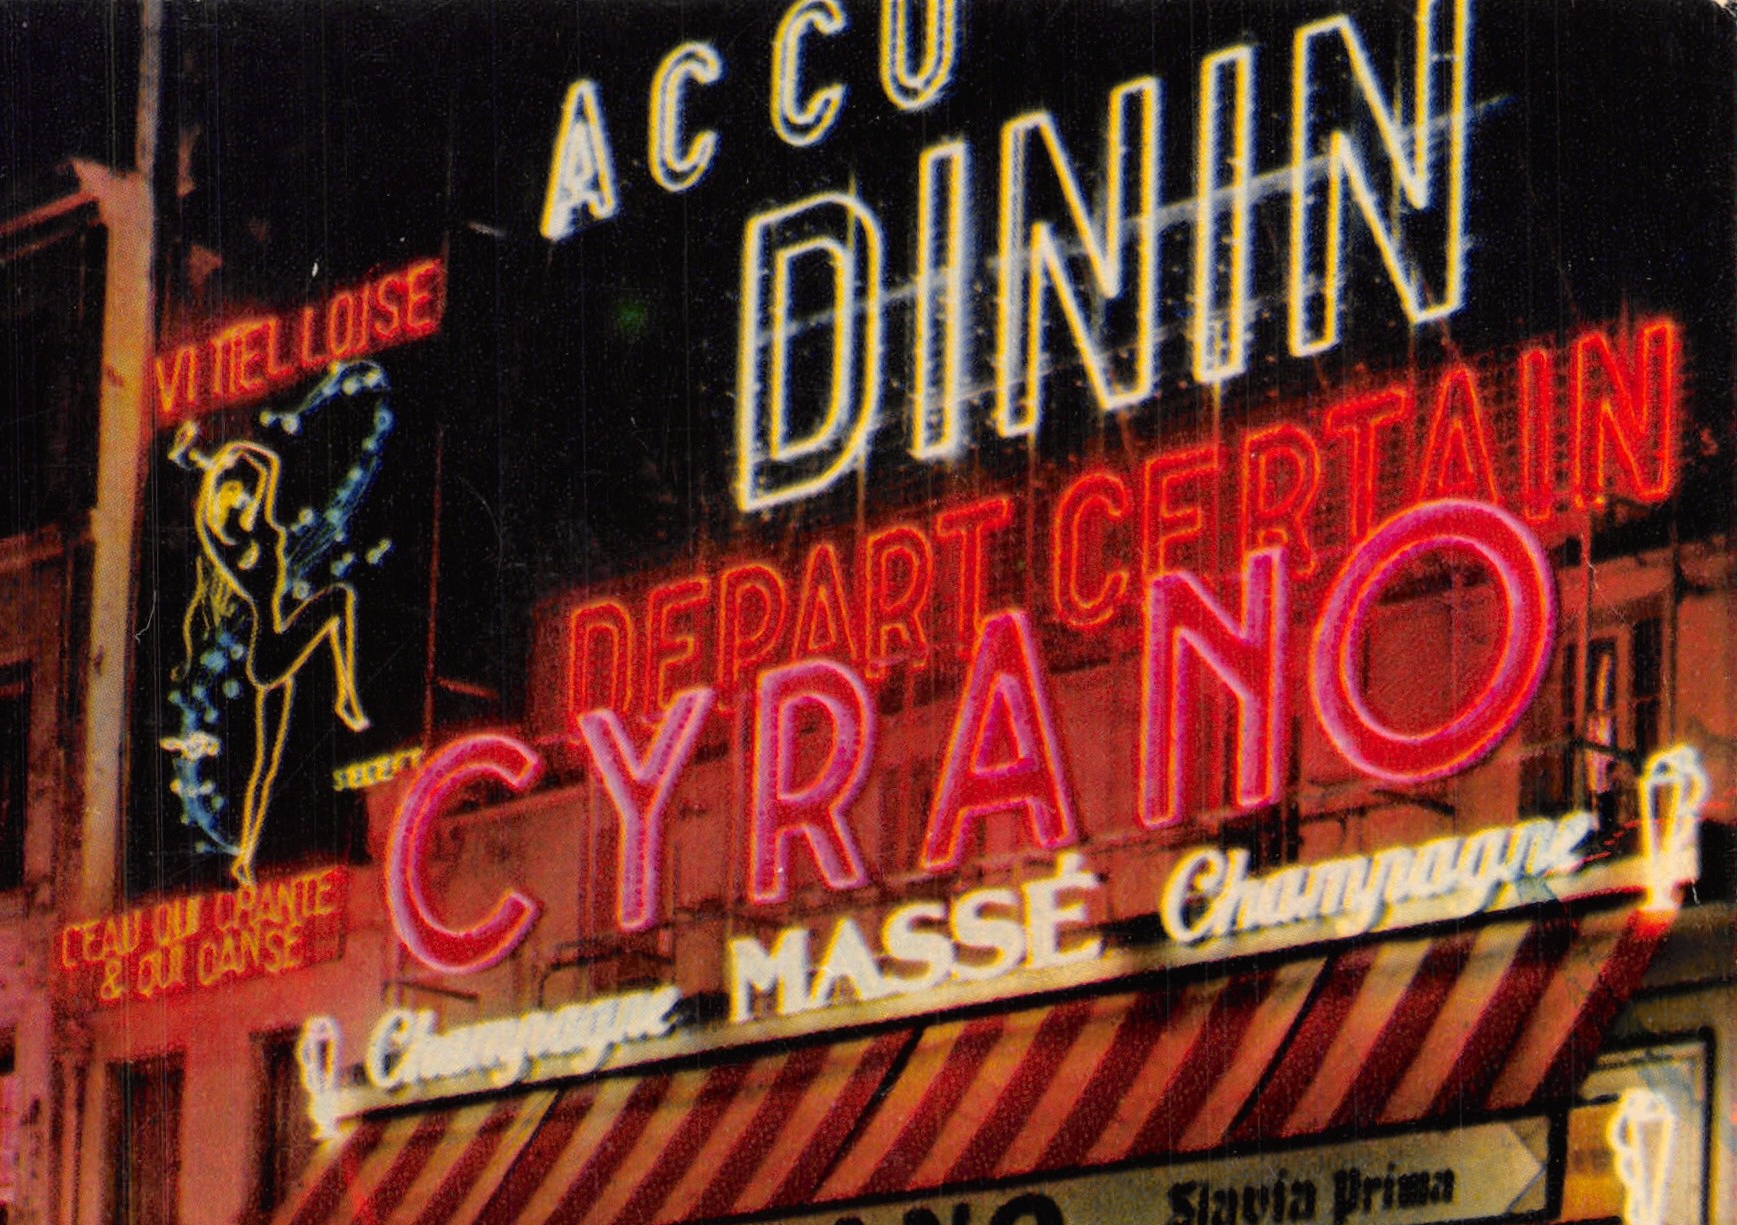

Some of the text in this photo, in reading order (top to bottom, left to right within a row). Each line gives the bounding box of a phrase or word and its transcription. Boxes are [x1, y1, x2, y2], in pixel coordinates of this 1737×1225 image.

[736, 0, 1470, 512] DININ
[385, 497, 1557, 974] CYRANO
[565, 316, 1679, 740] DEPART CERTAIN
[365, 807, 1597, 1091] Champagne MASSÉ Champagne
